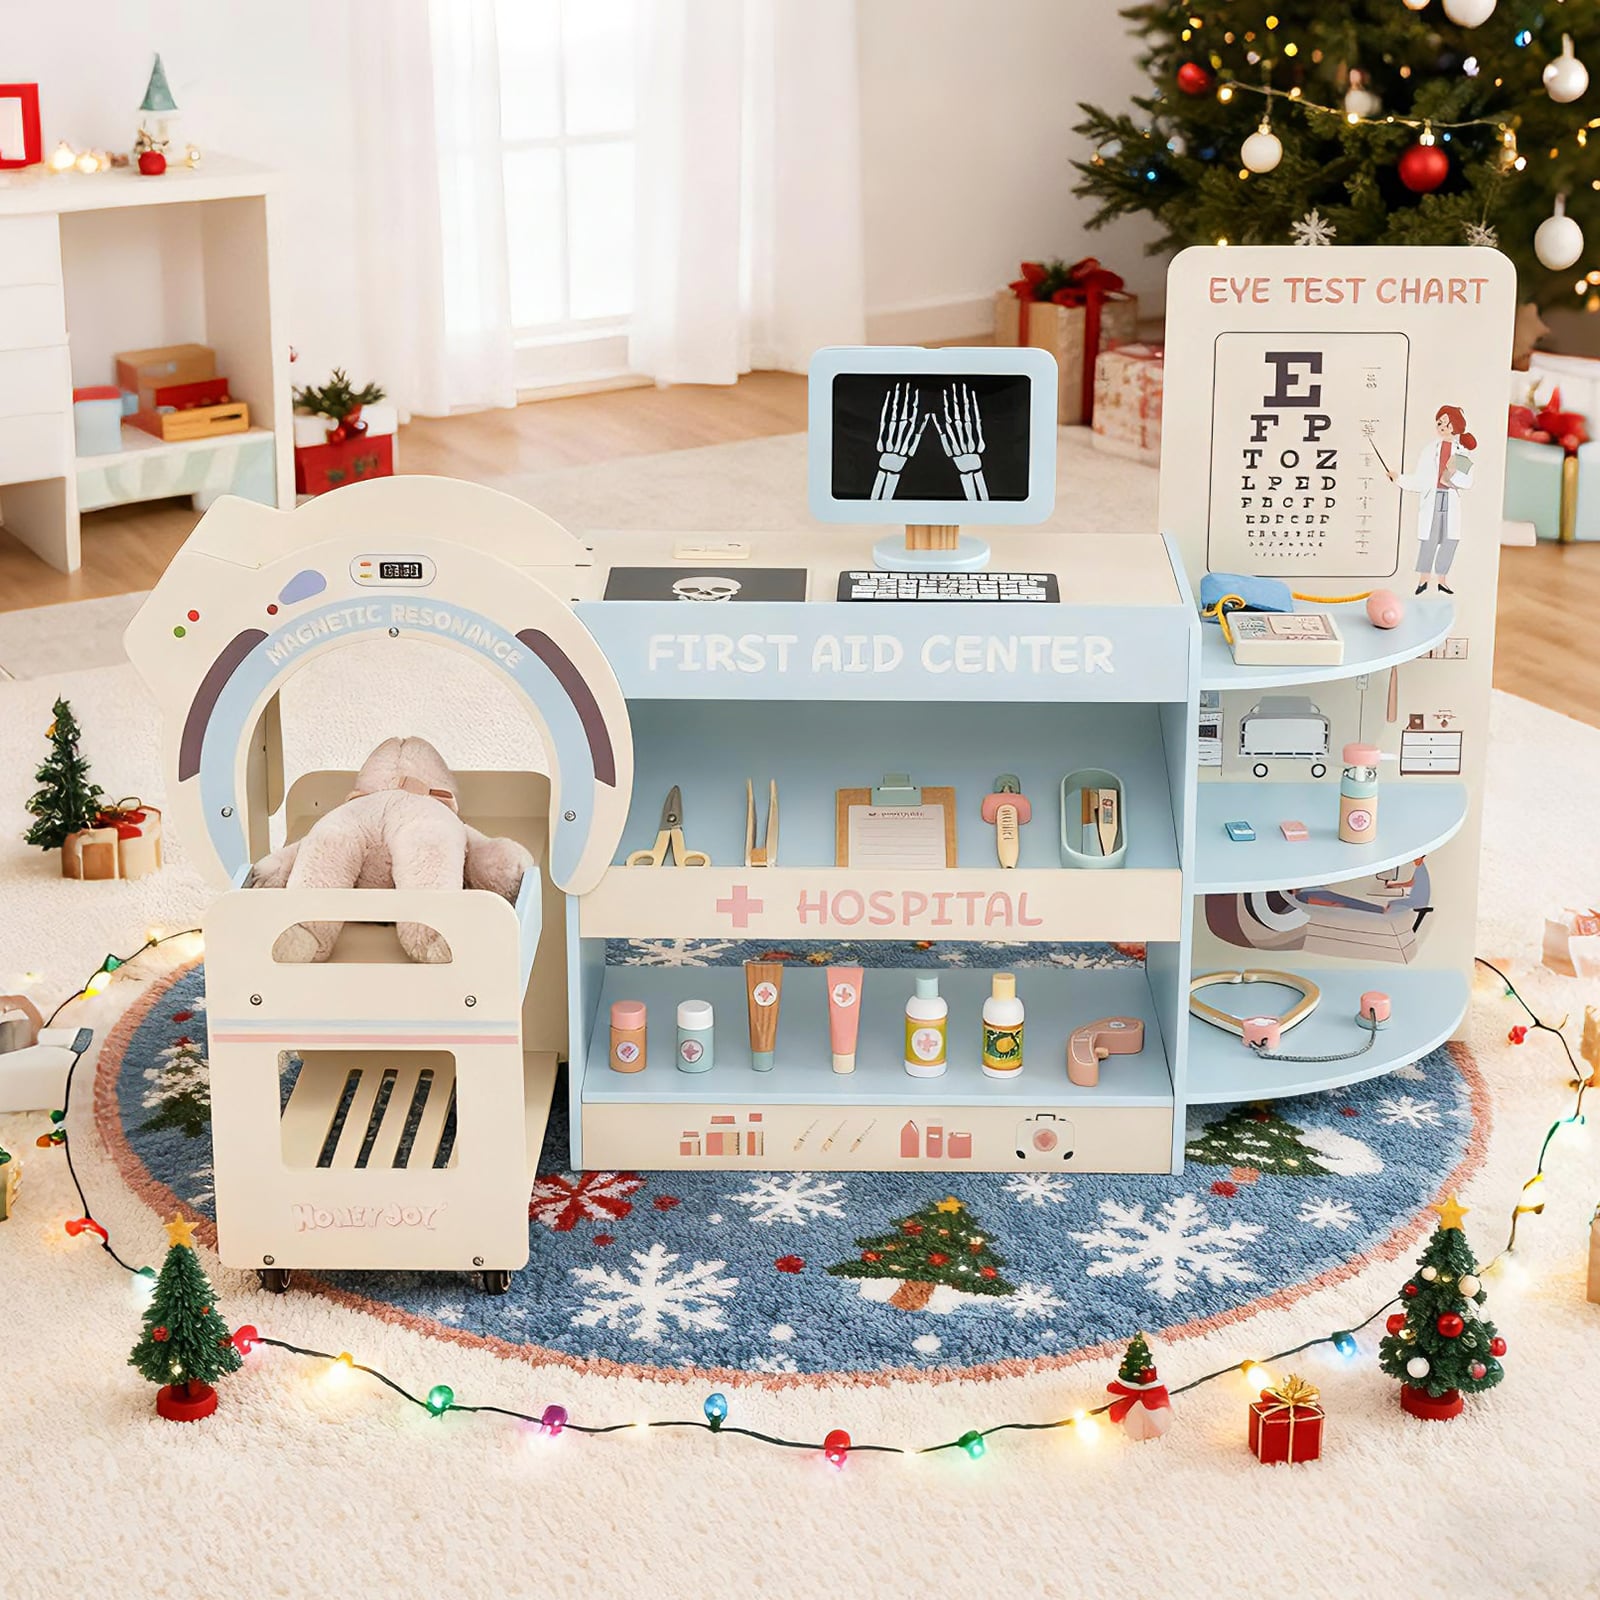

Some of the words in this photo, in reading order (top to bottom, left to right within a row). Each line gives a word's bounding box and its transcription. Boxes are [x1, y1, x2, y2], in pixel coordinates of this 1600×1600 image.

[1208, 277, 1271, 304] EYE
[1283, 277, 1367, 304] TEST
[1375, 277, 1489, 304] CHART
[1263, 351, 1323, 408] E
[1250, 414, 1280, 443] F
[1302, 414, 1332, 443] P
[265, 604, 384, 666] MAGNETIC
[390, 603, 525, 669] RESONANCE
[647, 633, 799, 674] FIRST
[811, 633, 905, 674] AID
[919, 633, 1116, 674] CENTER
[796, 889, 1044, 927] HOSPITAL
